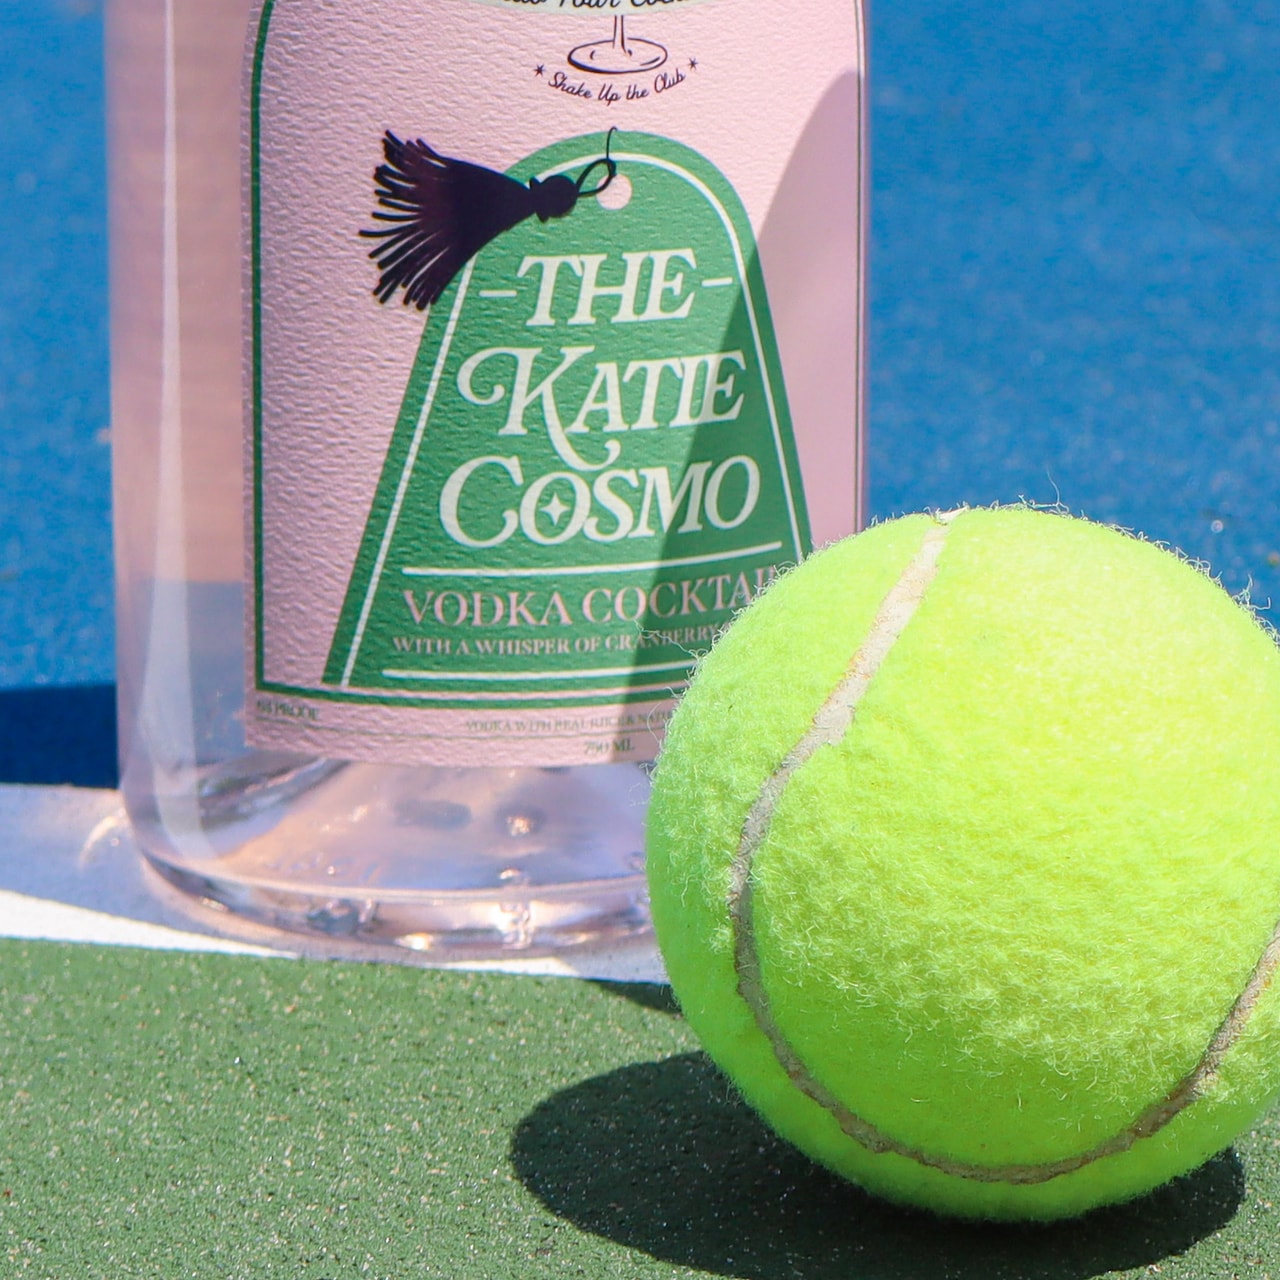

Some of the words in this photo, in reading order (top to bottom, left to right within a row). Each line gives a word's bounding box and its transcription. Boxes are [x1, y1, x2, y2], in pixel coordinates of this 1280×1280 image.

[548, 71, 593, 100] Shake
[597, 83, 622, 107] Up
[625, 83, 650, 101] the
[654, 67, 686, 94] Club
[456, 344, 747, 472] KATIE
[438, 454, 761, 549] COSMO
[401, 589, 574, 628] VODKA
[581, 566, 776, 624] COCKTAI
[392, 636, 452, 655] WITH
[456, 638, 472, 656] A
[474, 637, 571, 656] WHISPER
[574, 635, 601, 653] OF
[604, 622, 721, 652] CRANBERRY
